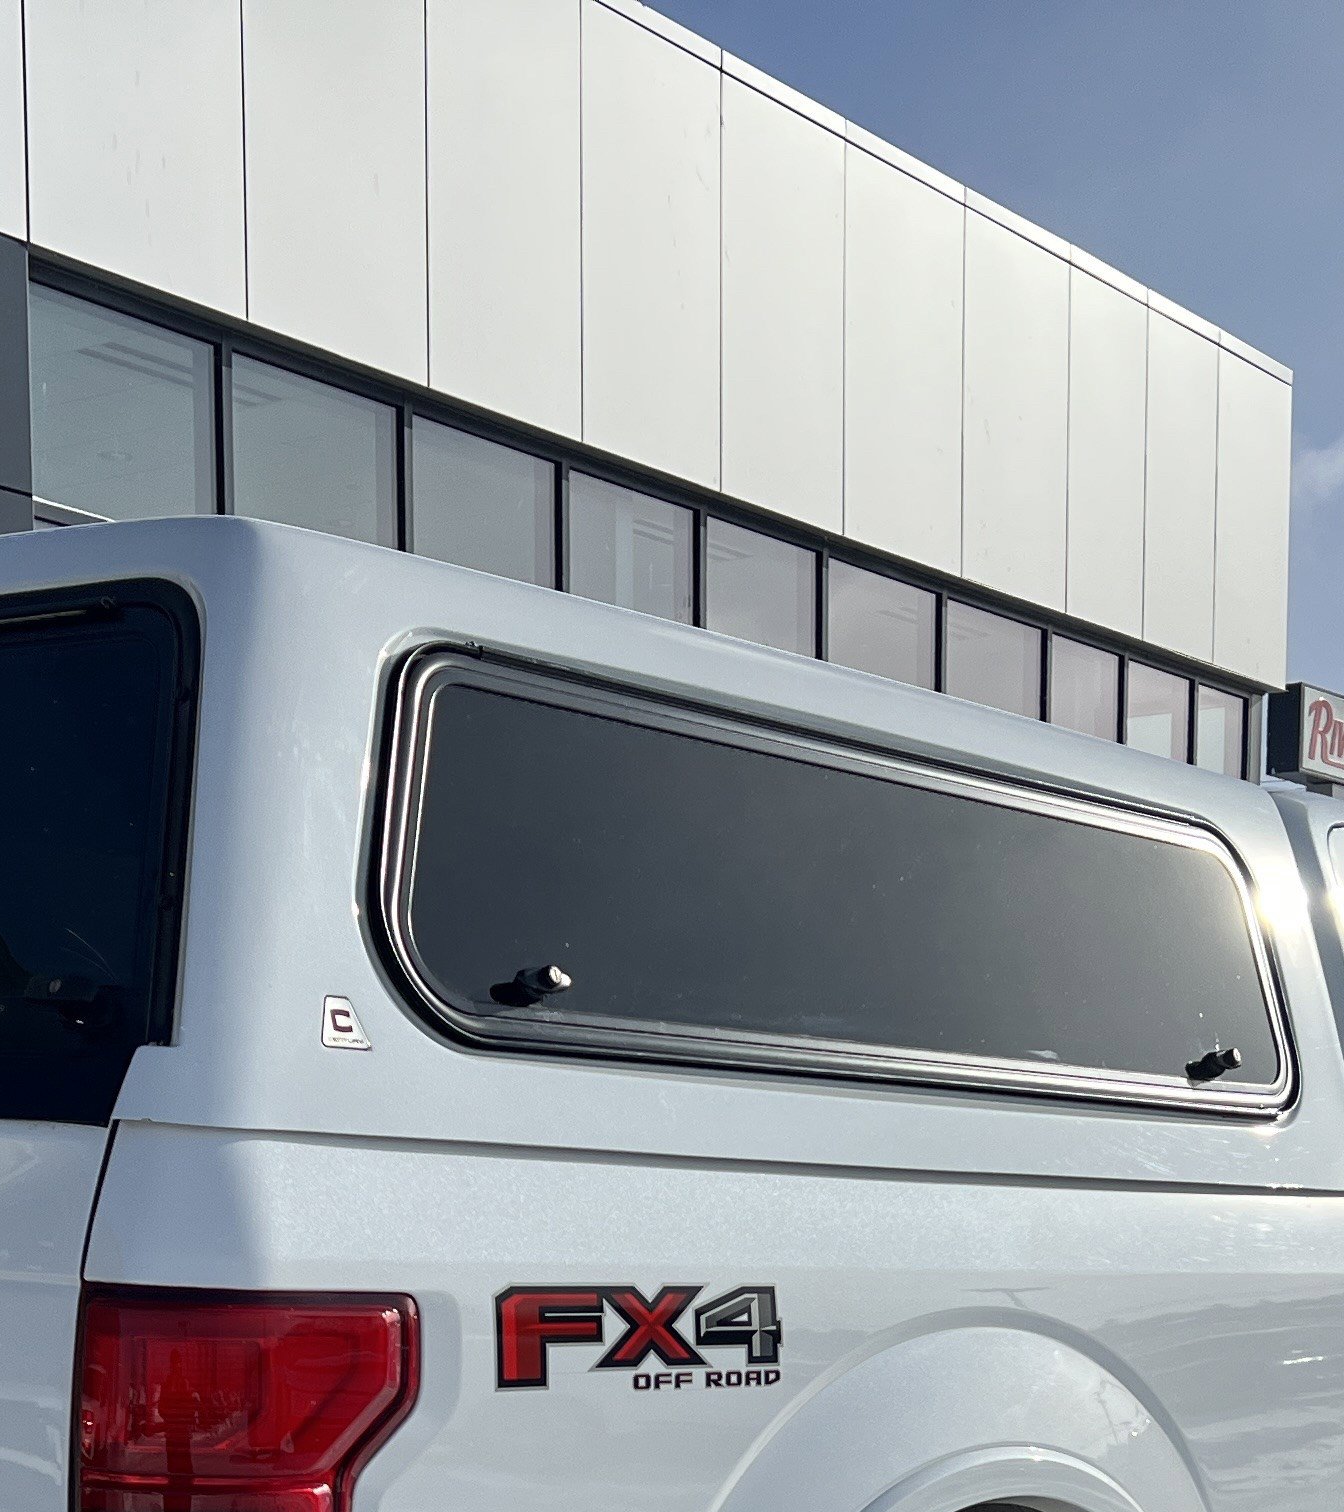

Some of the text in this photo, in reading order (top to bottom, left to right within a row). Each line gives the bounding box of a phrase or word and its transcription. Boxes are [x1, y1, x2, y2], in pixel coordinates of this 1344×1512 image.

[330, 1008, 353, 1032] C
[494, 1282, 783, 1392] FX4
[633, 1369, 781, 1390] OFF ROAD
